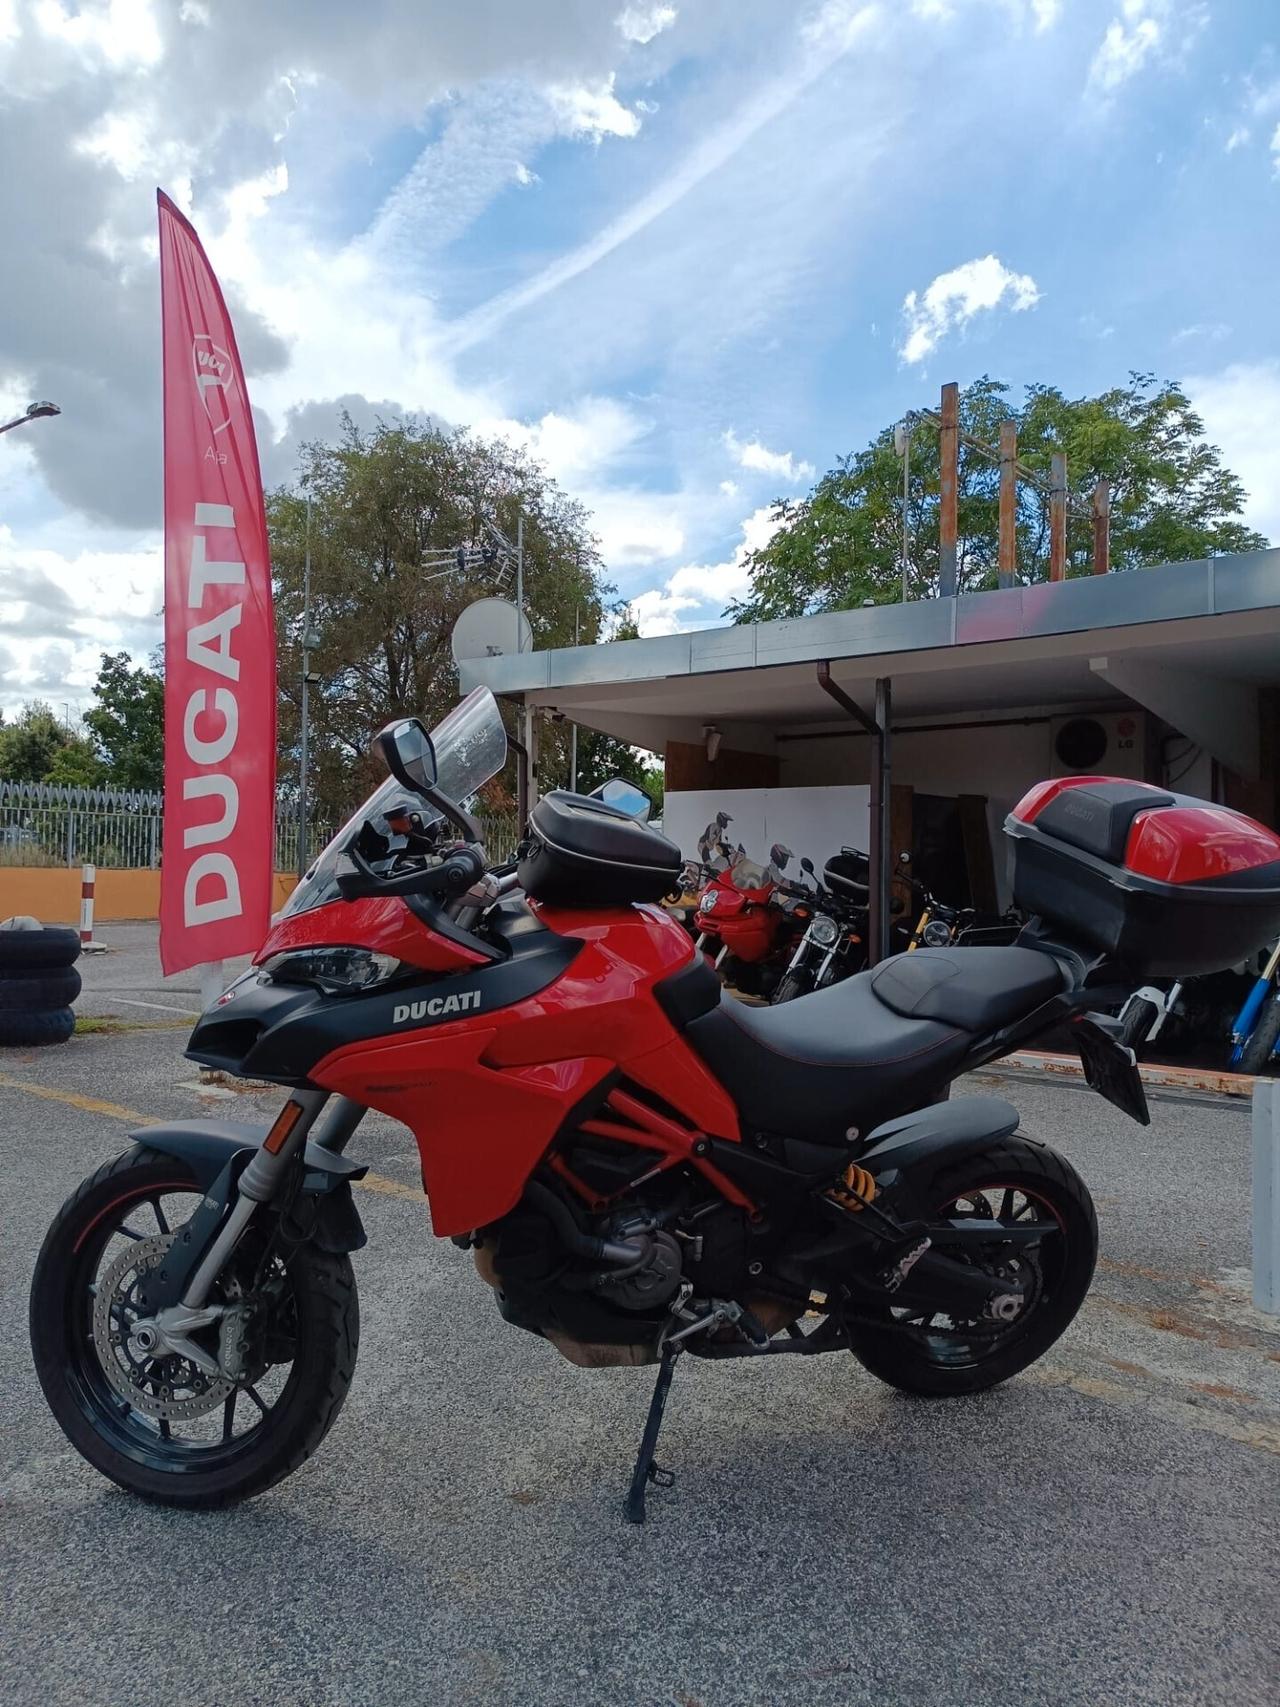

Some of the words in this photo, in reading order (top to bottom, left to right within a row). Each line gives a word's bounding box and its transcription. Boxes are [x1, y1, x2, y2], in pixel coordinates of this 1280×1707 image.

[184, 502, 246, 928] DUCATI
[1118, 739, 1134, 749] LG
[393, 990, 481, 1024] DUCATI
